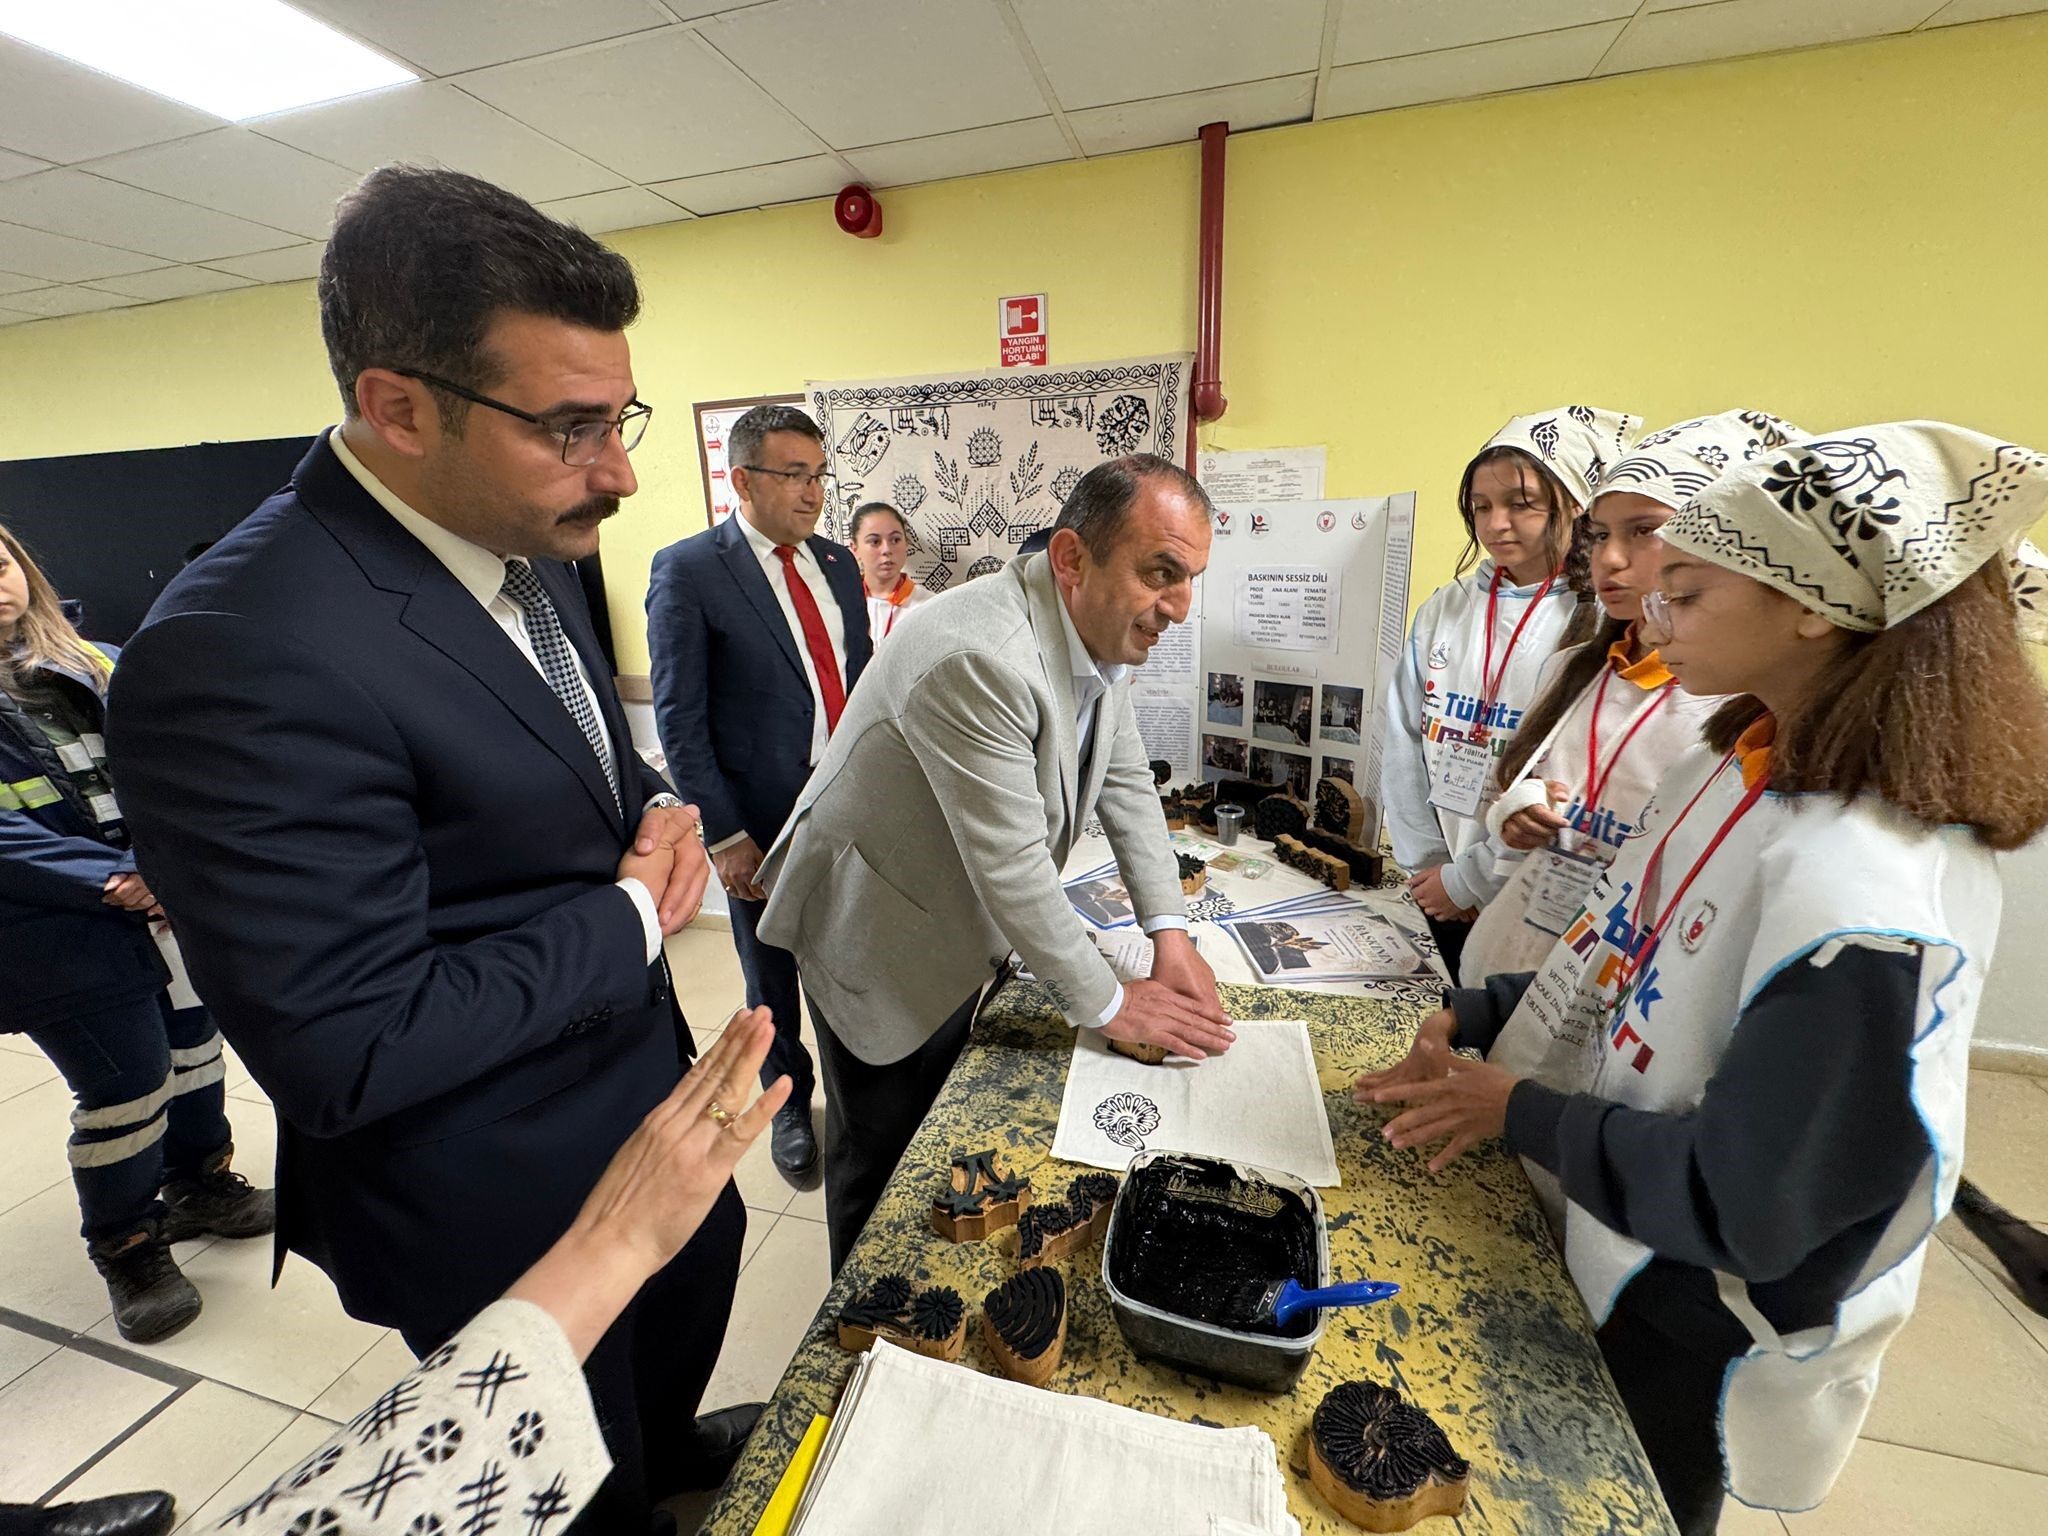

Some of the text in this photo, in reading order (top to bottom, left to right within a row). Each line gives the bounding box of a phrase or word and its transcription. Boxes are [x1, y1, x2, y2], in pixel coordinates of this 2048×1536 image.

[1007, 337, 1039, 346] YANGIN
[1003, 345, 1044, 355] HORTUMU
[1008, 353, 1039, 362] DOLABI
[1248, 573, 1327, 582] BASKININ SESSİZ DİLİ
[1445, 692, 1525, 730] Tübita
